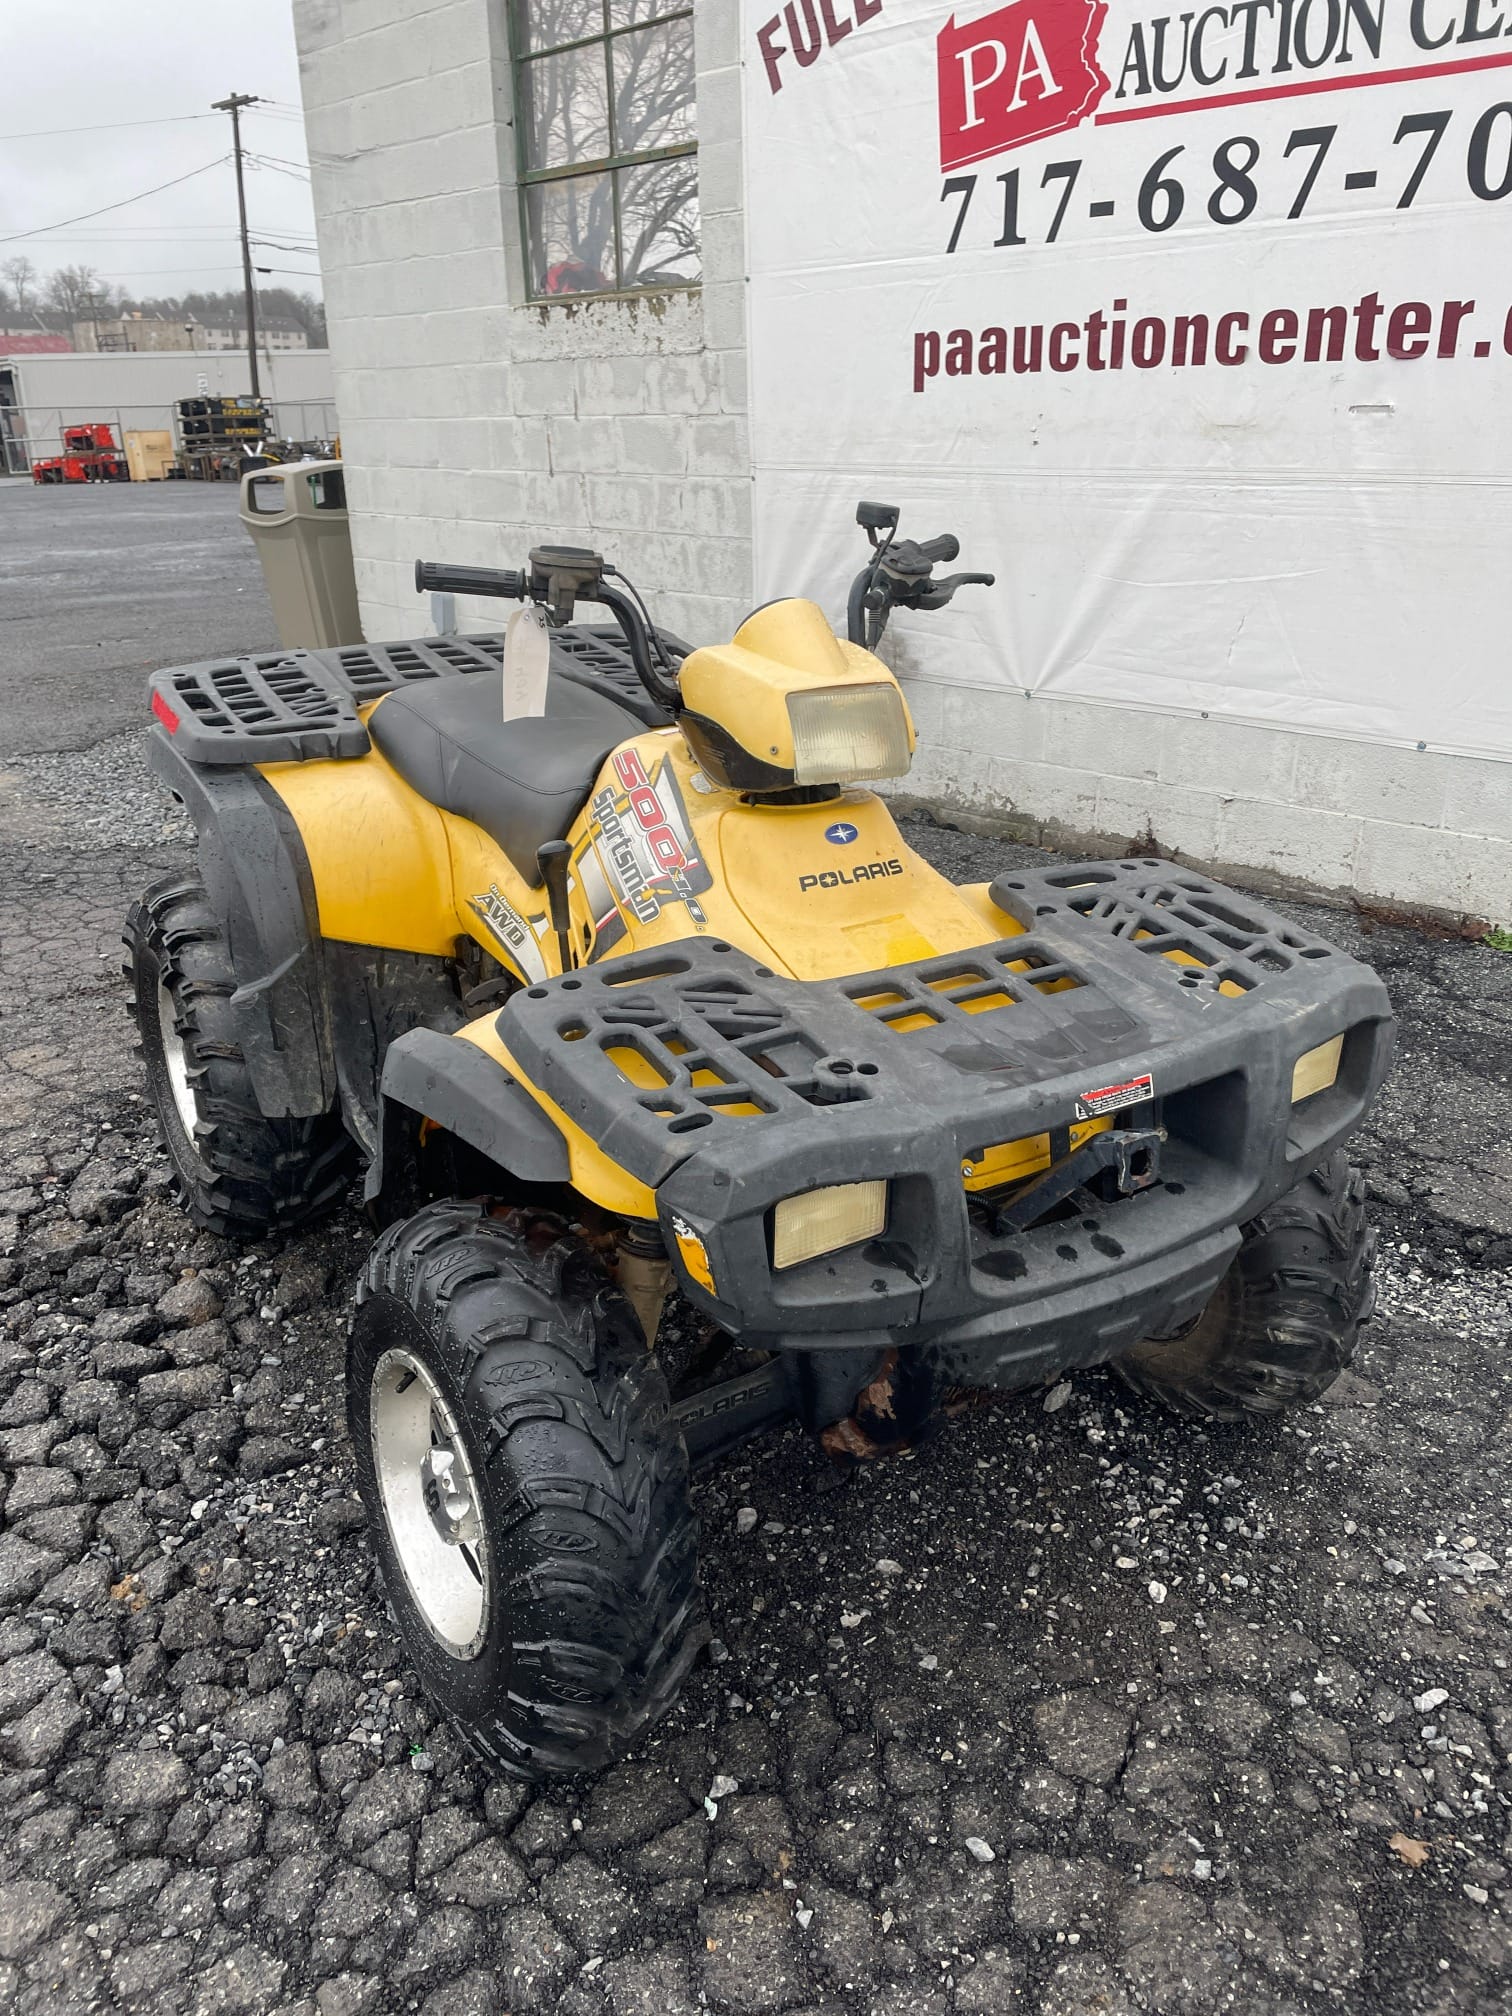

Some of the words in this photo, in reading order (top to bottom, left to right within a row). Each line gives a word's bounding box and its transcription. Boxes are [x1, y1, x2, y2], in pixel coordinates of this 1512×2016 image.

[953, 17, 1064, 134] PA
[1115, 0, 1385, 99] AUCTION
[1410, 0, 1512, 51] CE
[913, 291, 1512, 393] paauctioncenter.
[592, 786, 662, 925] Sportsman
[612, 748, 688, 875] 500
[473, 892, 527, 949] AWD
[799, 859, 904, 892] POLARIS
[673, 1382, 771, 1428] OLARIS
